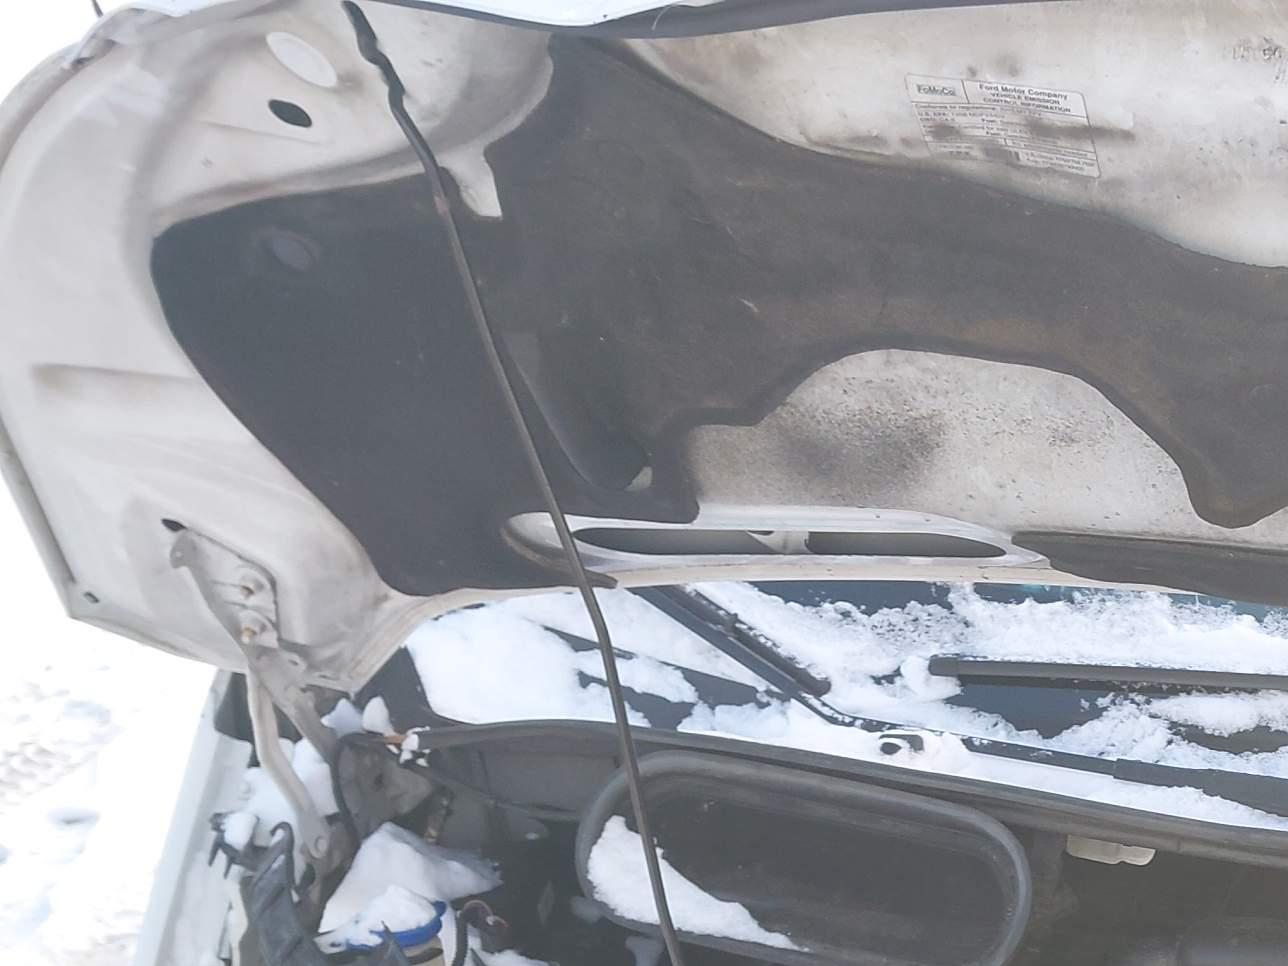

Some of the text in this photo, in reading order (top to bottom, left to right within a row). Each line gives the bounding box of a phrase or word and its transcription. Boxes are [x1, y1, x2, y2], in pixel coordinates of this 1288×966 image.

[917, 84, 957, 96] FoMoCo
[979, 83, 1068, 100] Ford Motor Company
